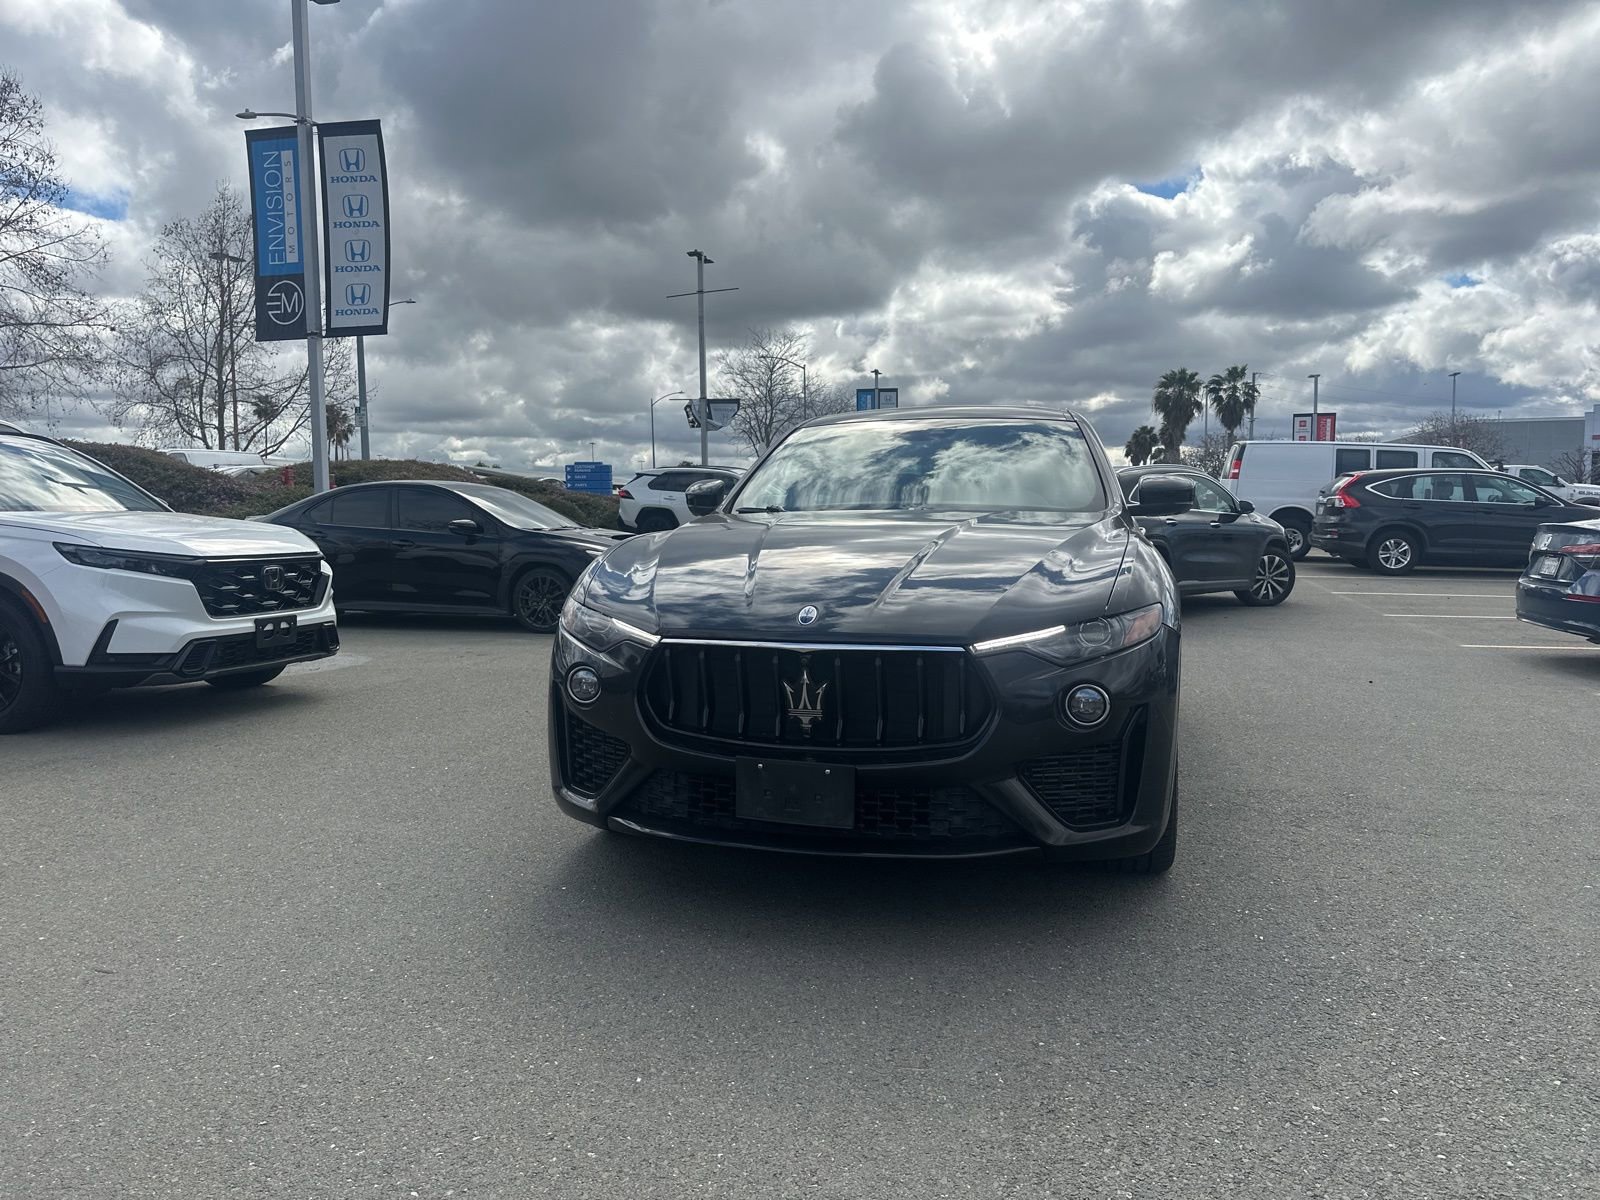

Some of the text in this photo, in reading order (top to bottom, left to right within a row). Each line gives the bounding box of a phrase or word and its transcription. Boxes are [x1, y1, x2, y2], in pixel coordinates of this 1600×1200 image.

[330, 175, 377, 183] HONDA
[262, 151, 285, 264] ENVISION
[284, 160, 295, 254] MOTORS
[335, 265, 381, 273] HONDA
[335, 308, 380, 316] HONDA
